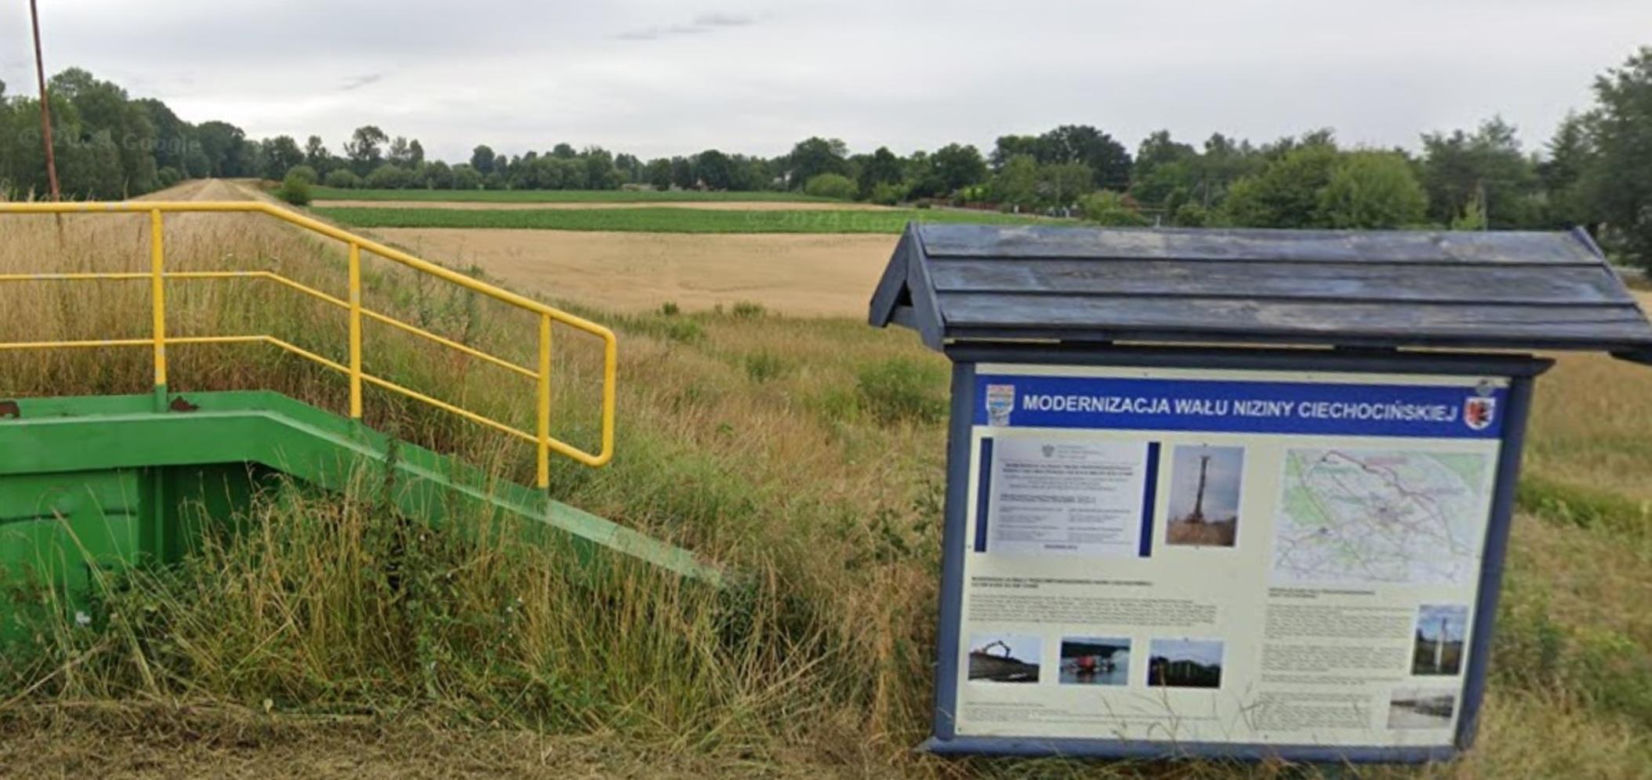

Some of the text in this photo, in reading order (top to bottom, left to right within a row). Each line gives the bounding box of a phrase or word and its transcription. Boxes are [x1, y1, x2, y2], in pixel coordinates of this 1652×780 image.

[1023, 395, 1459, 422] MODERNIZACJA WAŁU NIZINY CIECHOCIŃSKIEJ
